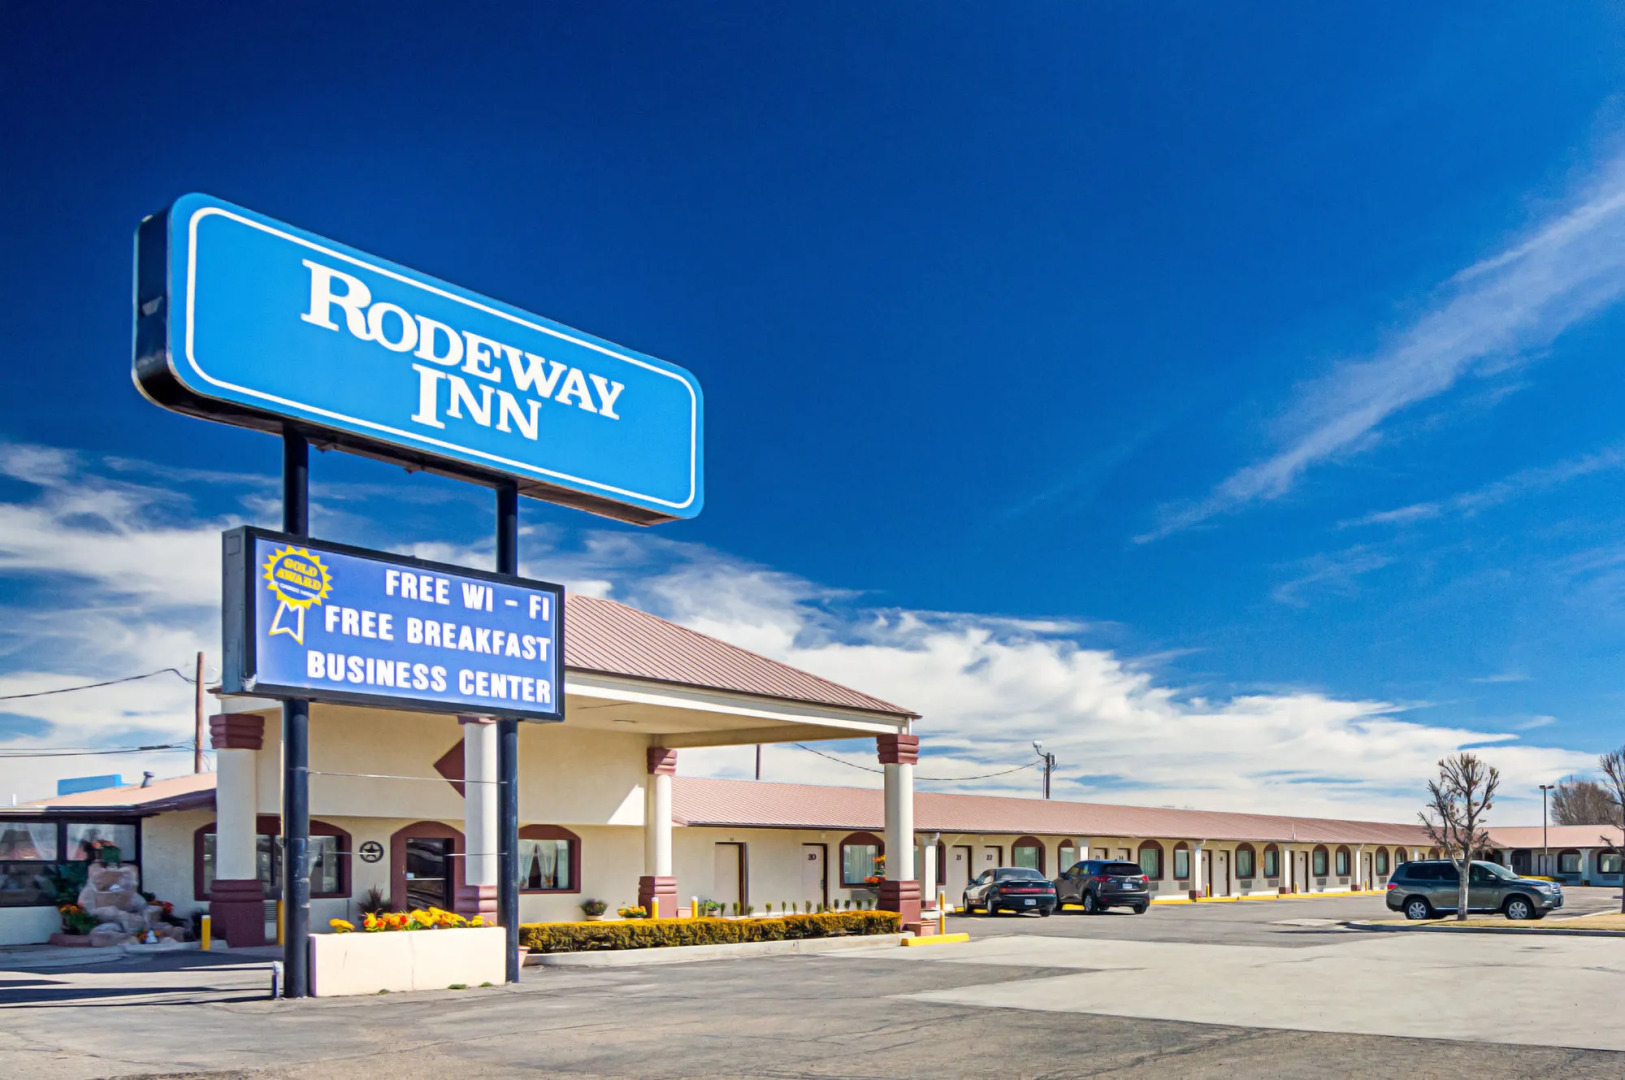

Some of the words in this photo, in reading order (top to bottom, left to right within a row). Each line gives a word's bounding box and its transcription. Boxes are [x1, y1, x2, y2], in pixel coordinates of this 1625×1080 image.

[302, 259, 625, 420] RODEWAY
[411, 363, 542, 441] INN
[275, 568, 322, 590] AWARD
[283, 557, 318, 577] GOLD
[385, 569, 450, 605] FREE
[461, 582, 493, 612] WI
[529, 594, 550, 621] FI
[325, 605, 394, 641] FREE
[406, 617, 551, 662] BREAKFAST
[307, 650, 447, 692] BUSINESS
[458, 669, 551, 703] CENTER
